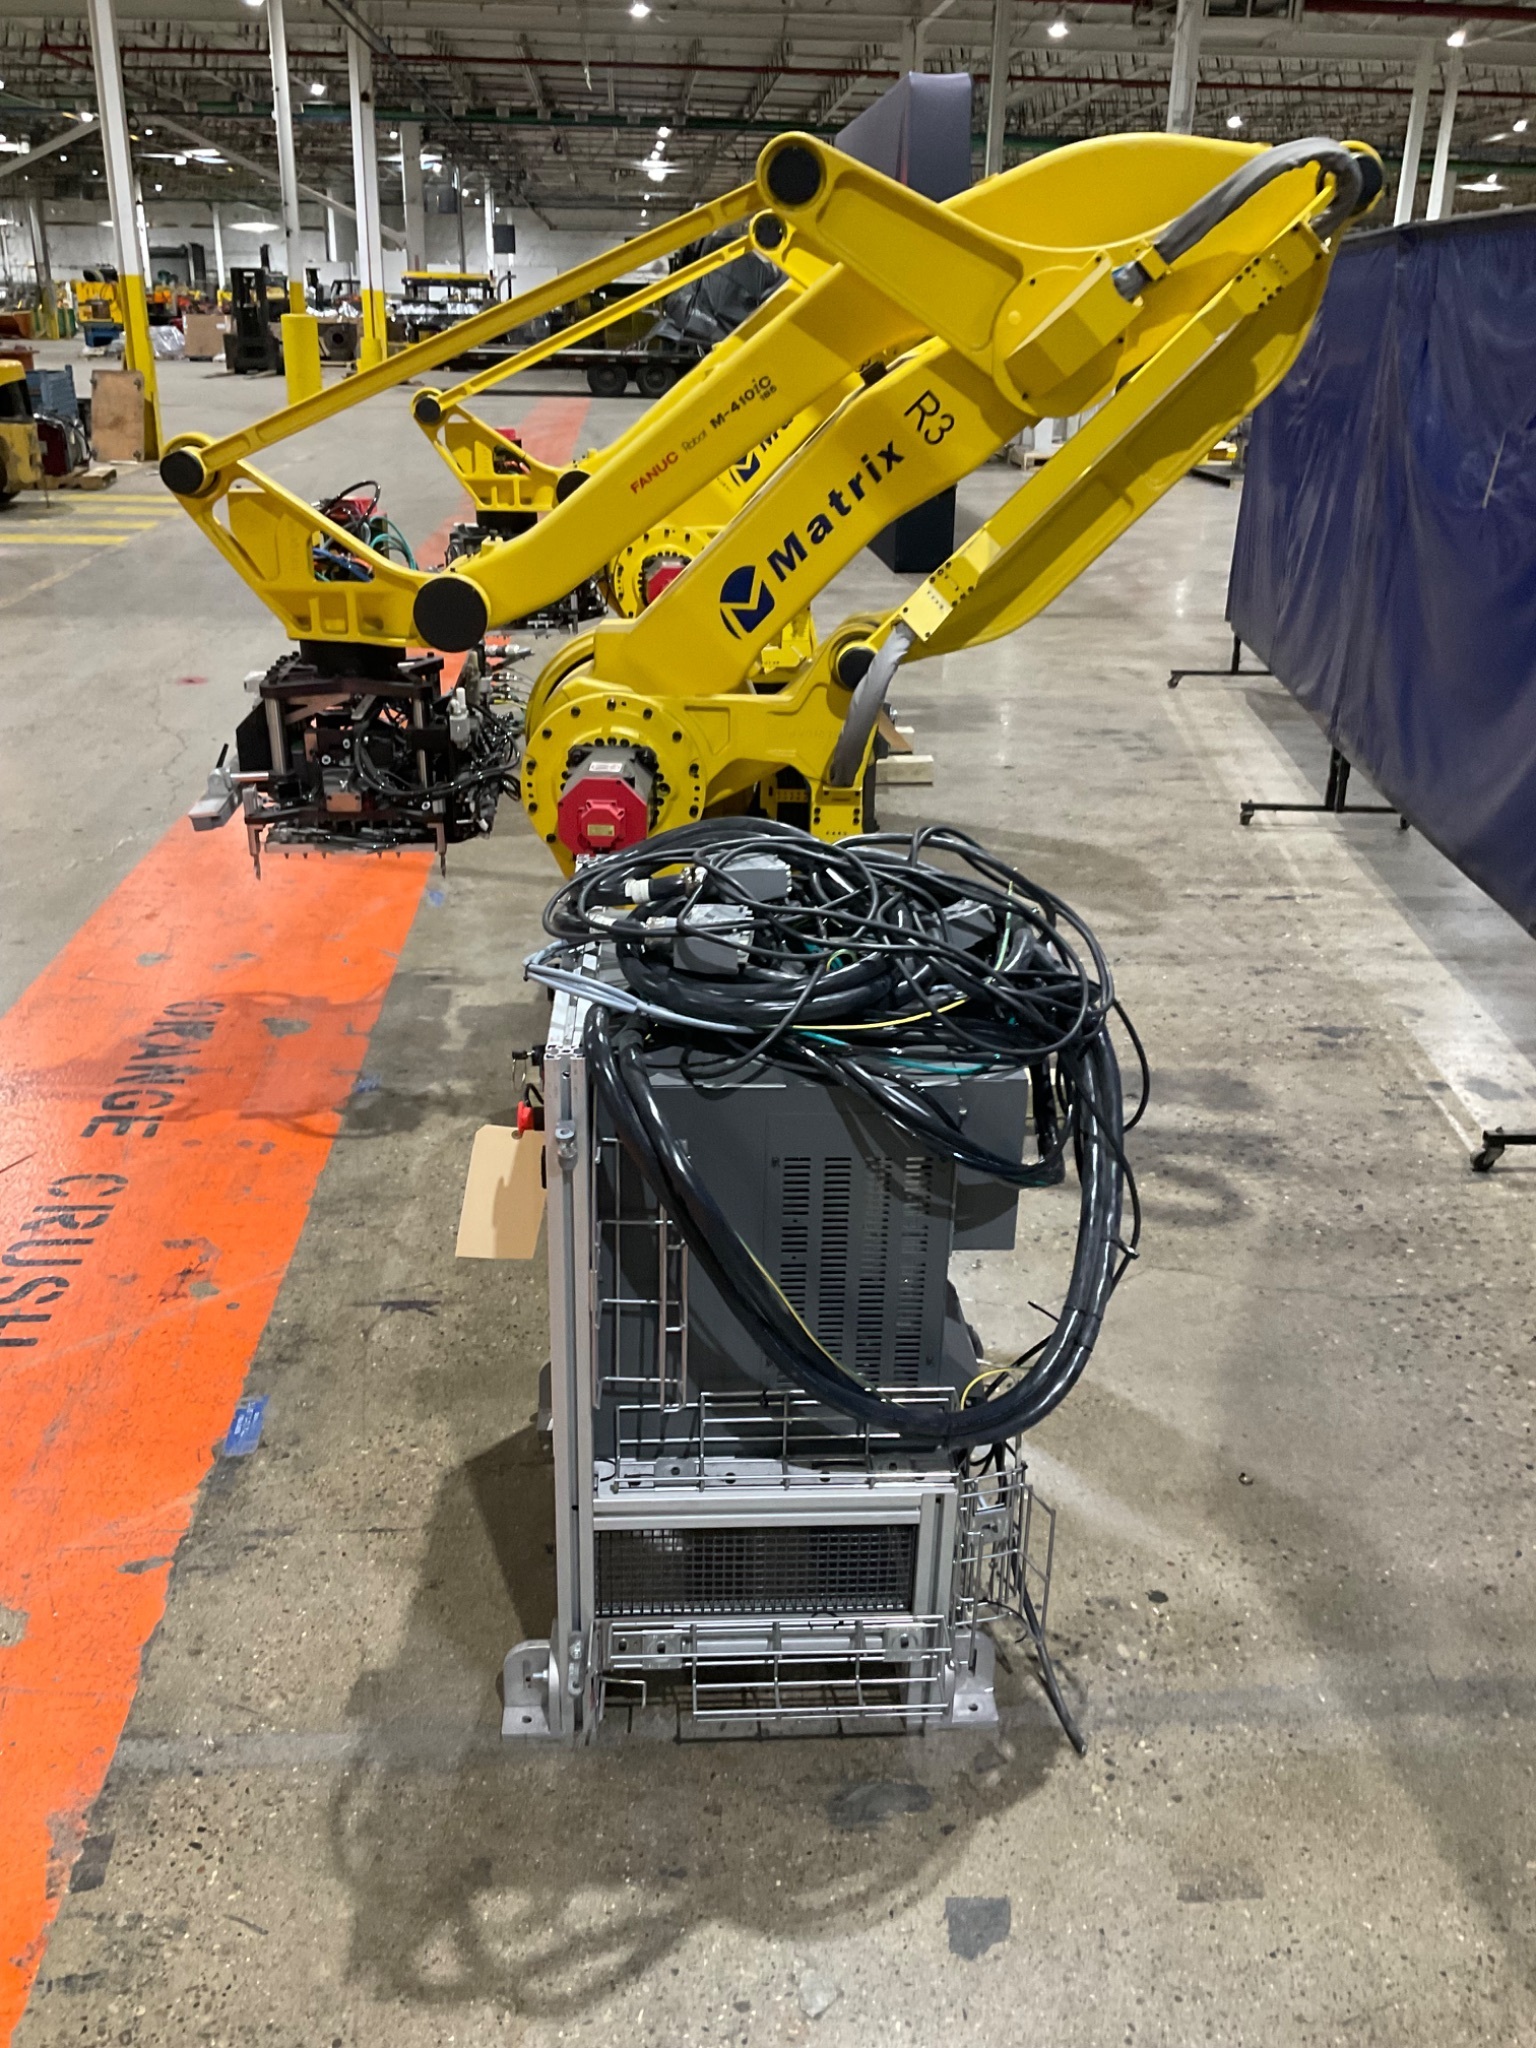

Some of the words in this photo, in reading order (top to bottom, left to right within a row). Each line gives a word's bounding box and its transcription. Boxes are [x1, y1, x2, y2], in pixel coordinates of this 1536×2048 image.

[630, 451, 679, 494] FANUC
[681, 429, 707, 453] Robot
[709, 375, 771, 430] M-410iC
[904, 389, 955, 445] R3
[766, 440, 905, 583] Matrix
[80, 1001, 225, 1138] ORANGE
